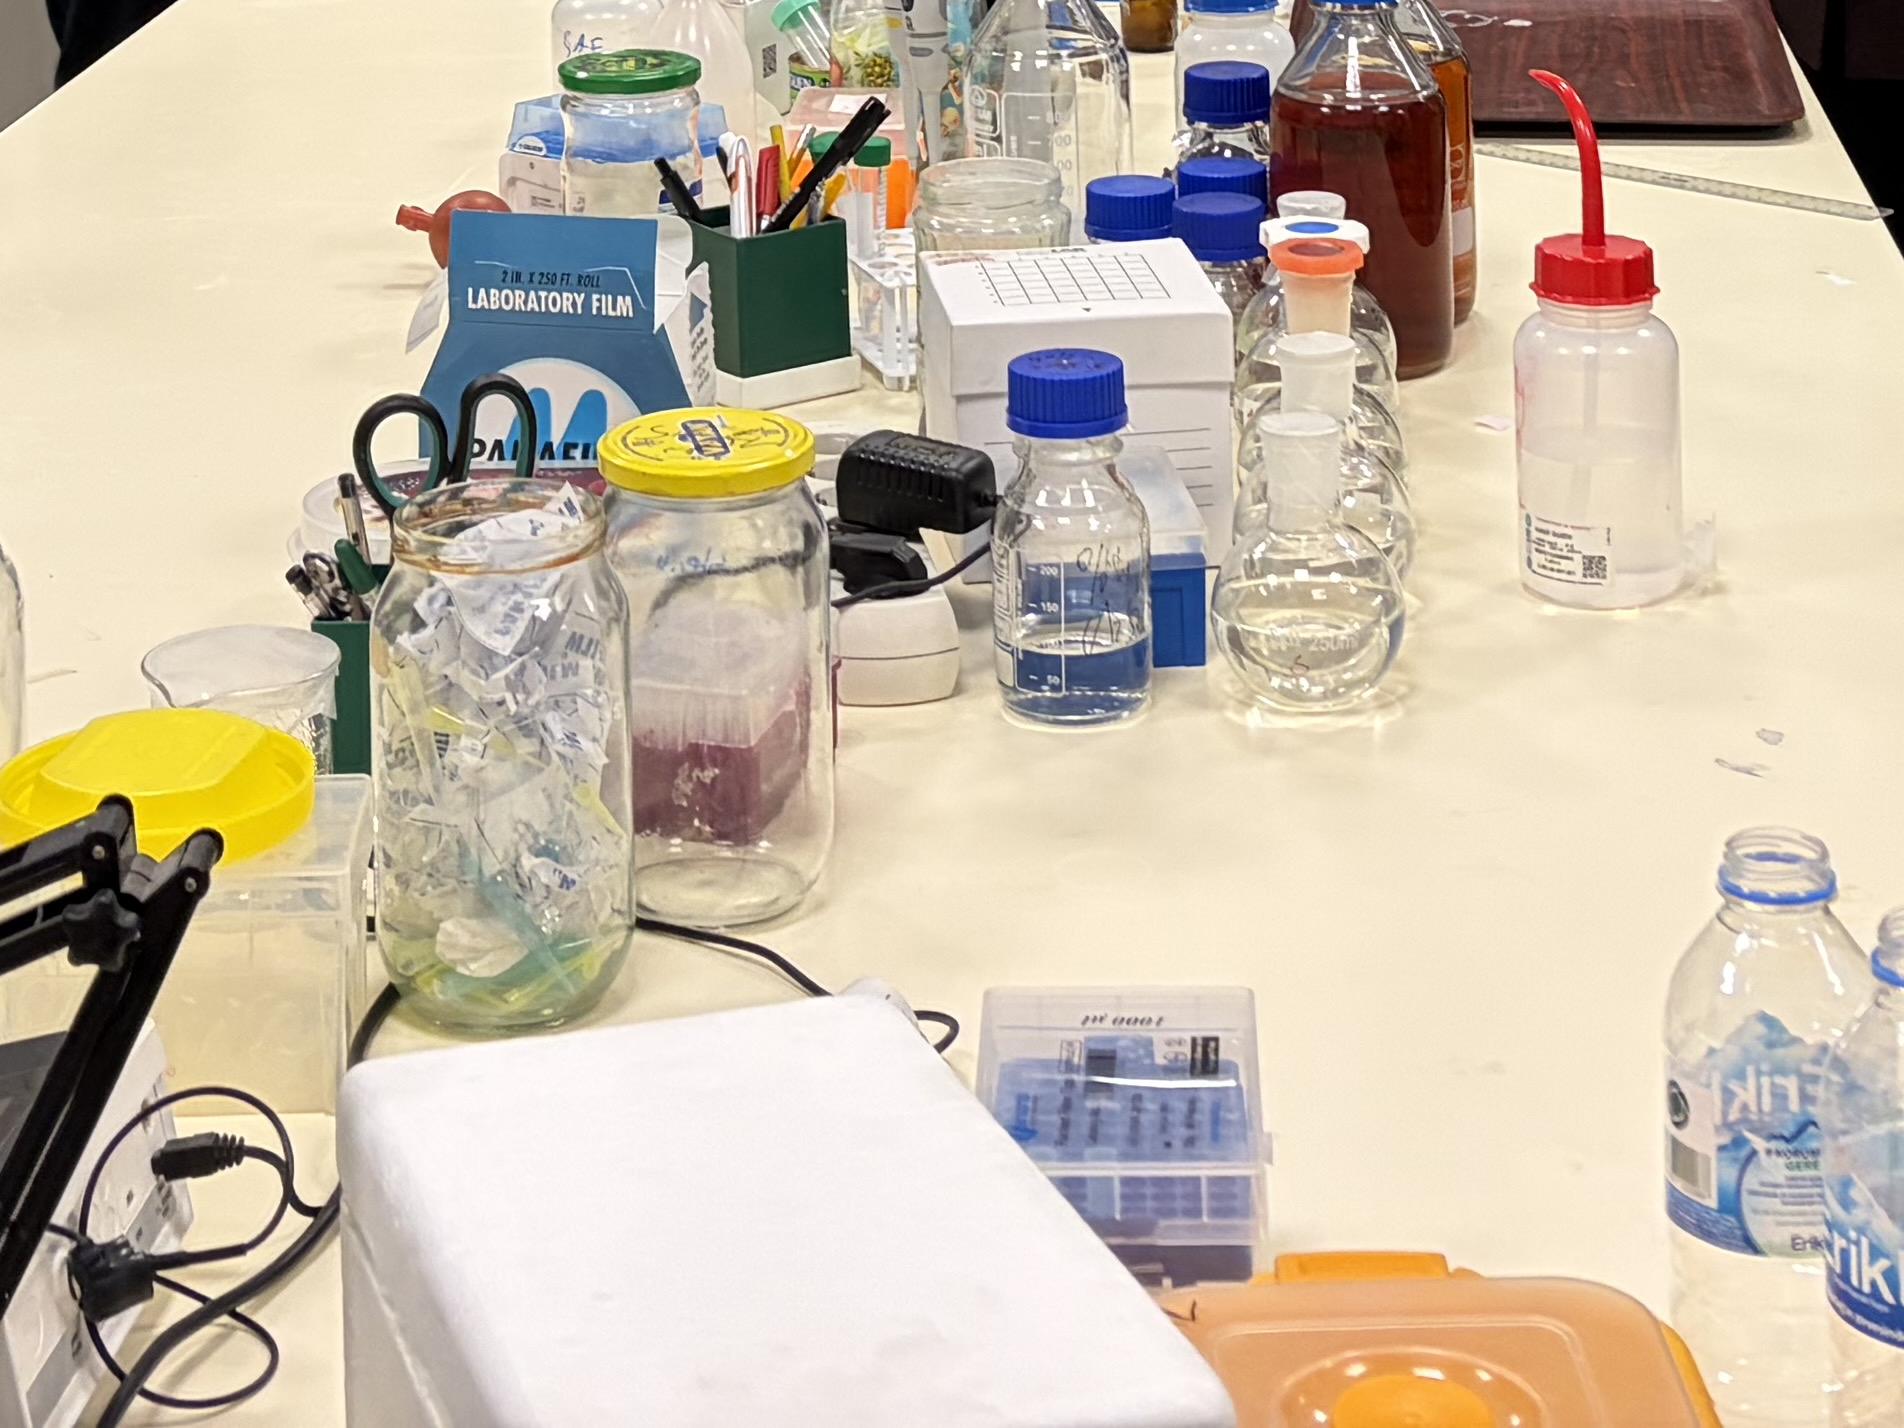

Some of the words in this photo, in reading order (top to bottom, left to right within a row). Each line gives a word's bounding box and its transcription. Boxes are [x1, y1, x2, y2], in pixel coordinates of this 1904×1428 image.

[501, 269, 510, 284] 2
[528, 272, 536, 284] X
[537, 271, 558, 286] 250
[576, 273, 601, 289] ROLL
[467, 286, 586, 315] LABORATORY
[591, 294, 635, 319] FILM
